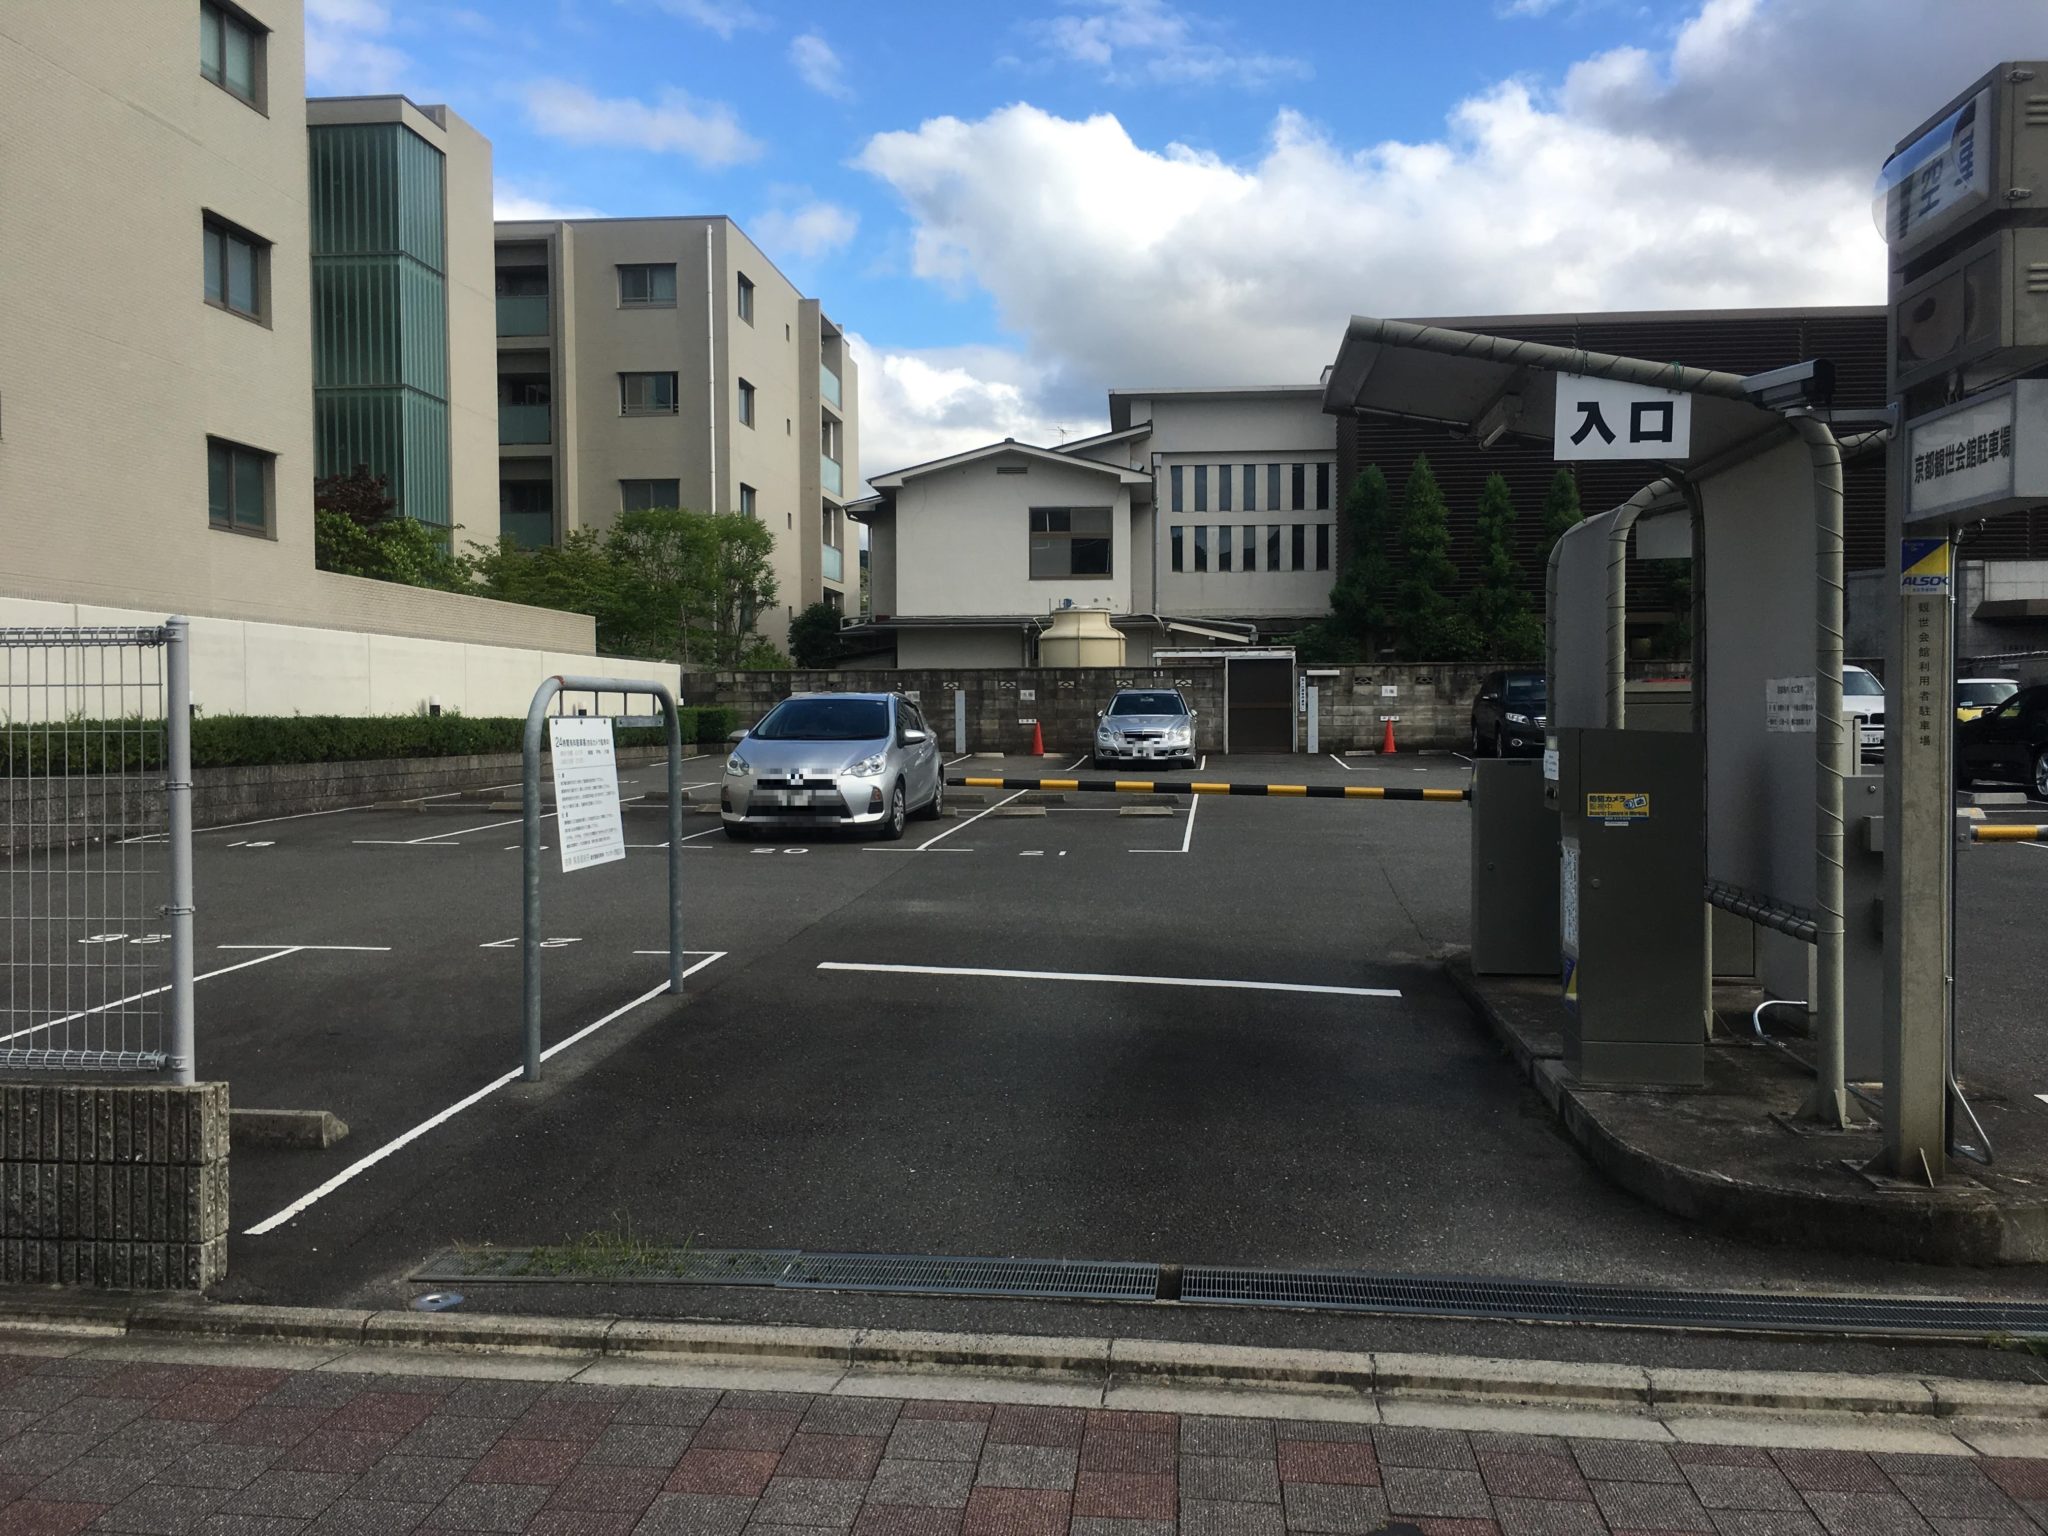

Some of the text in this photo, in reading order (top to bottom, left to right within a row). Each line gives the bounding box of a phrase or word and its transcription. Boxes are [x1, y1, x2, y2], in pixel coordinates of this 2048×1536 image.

[1570, 402, 1674, 445] 入口
[1914, 425, 2011, 484] 京都観世会館駐車場
[1918, 602, 1931, 746] 観世会館利用者駐車場
